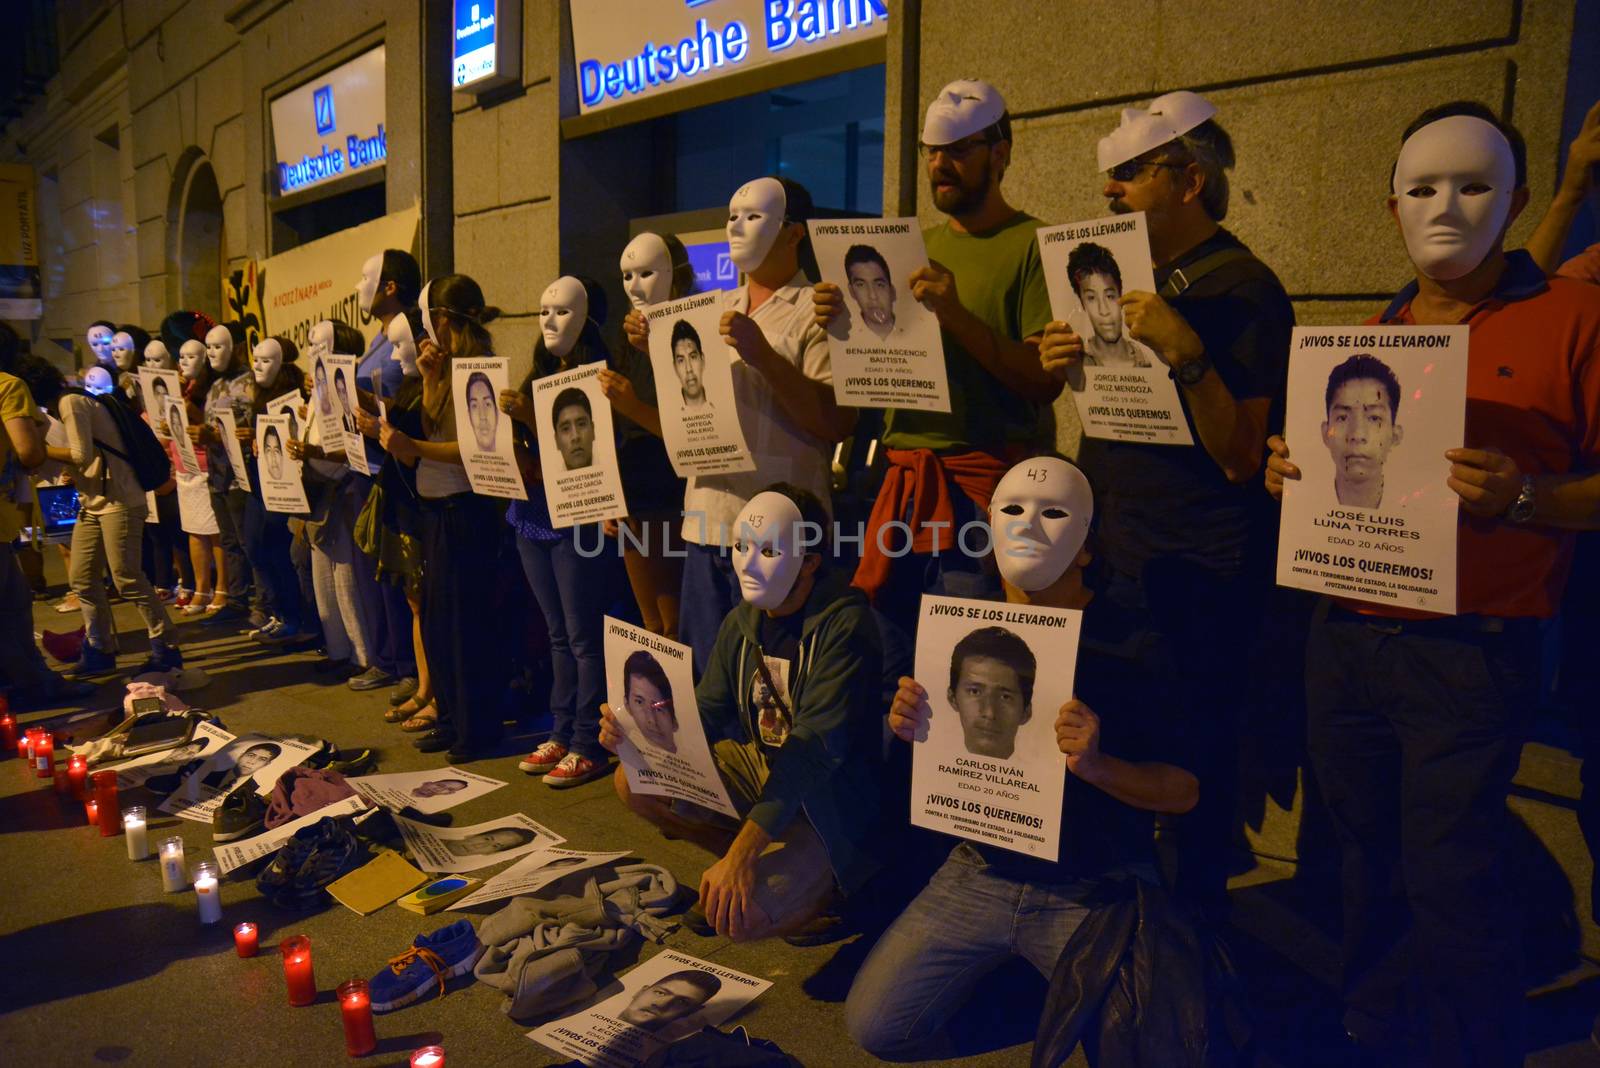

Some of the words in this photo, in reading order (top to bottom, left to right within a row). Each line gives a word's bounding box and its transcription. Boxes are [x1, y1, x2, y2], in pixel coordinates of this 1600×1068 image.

[579, 18, 748, 107] Deutsche
[279, 144, 345, 191] Deutsche
[346, 123, 388, 169] Bank
[816, 225, 839, 236] ¡VIVOS
[840, 225, 849, 234] SE
[851, 225, 865, 234] LOS
[866, 224, 910, 234] LLEVARON!
[1044, 231, 1065, 245] ¡VIVOS
[1066, 229, 1075, 240] SE
[1076, 227, 1090, 239] LOS
[1092, 220, 1136, 236] LLEVARON!
[665, 307, 672, 315] SE
[672, 303, 683, 314] LOS
[1300, 335, 1334, 349] ¡VIVOS
[1337, 335, 1351, 348] SE
[1353, 335, 1376, 348] LOS
[1379, 335, 1451, 348] LLEVARON!
[870, 357, 908, 365] BAUTISTA
[845, 378, 872, 387] ¡VIVOS
[873, 378, 889, 387] LOS
[890, 378, 935, 390] QUEREMOS!
[1093, 383, 1113, 392] CRUZ
[1114, 385, 1152, 394] MENDOZA
[1088, 406, 1110, 416] ¡VIVOS
[1111, 407, 1125, 417] LOS
[1126, 408, 1171, 420] QUEREMOS!
[694, 447, 705, 456] LOS
[1027, 468, 1048, 482] 43
[573, 500, 584, 508] LOS
[748, 514, 764, 528] 43
[1327, 510, 1365, 522] JOSÉ
[1369, 514, 1405, 527] LUIS
[1314, 518, 1352, 531] LUNA
[1355, 524, 1421, 540] TORRES
[1328, 536, 1355, 546] EDAD
[1358, 540, 1371, 549] 20
[1374, 542, 1405, 553] AÑOS
[1294, 549, 1330, 565] ¡VIVOS
[1333, 555, 1355, 568] LOS
[1359, 559, 1434, 580] QUEREMOS!
[1292, 566, 1312, 575] CONTRA
[1320, 571, 1355, 583] TERRORISMO
[1397, 583, 1438, 595] SOLIDARIDAD
[930, 604, 965, 617] ¡VIVOS
[966, 608, 981, 619] SE
[982, 609, 1003, 621] LOS
[1005, 612, 1067, 628] LLEVARON!
[609, 624, 629, 639] ¡VIVOS
[629, 631, 637, 642] SE
[637, 635, 650, 647] LOS
[650, 639, 684, 660] LLEVARON!
[956, 757, 997, 772] CARLOS
[999, 765, 1024, 778] IVÁN
[938, 764, 983, 781] RAMÍREZ
[985, 774, 1041, 793] VILLAREAL
[958, 782, 981, 792] EDAD
[983, 786, 994, 795] 20
[996, 789, 1020, 801] AÑOS
[926, 793, 960, 809] ¡VIVOS
[962, 800, 981, 814] LOS
[983, 806, 1043, 830] QUEREMOS!
[925, 809, 943, 818] CONTRA
[950, 814, 980, 827] TERRORISMO
[1014, 829, 1046, 843] SOLIDARIDAD
[663, 954, 691, 965] ¡VIVOS
[690, 961, 701, 970] SE
[700, 965, 718, 973] LOS
[716, 970, 760, 987] LLEVARON!
[590, 1013, 624, 1028] JORGE
[553, 1027, 583, 1041] ¡VIVOS
[582, 1038, 598, 1048] LOS
